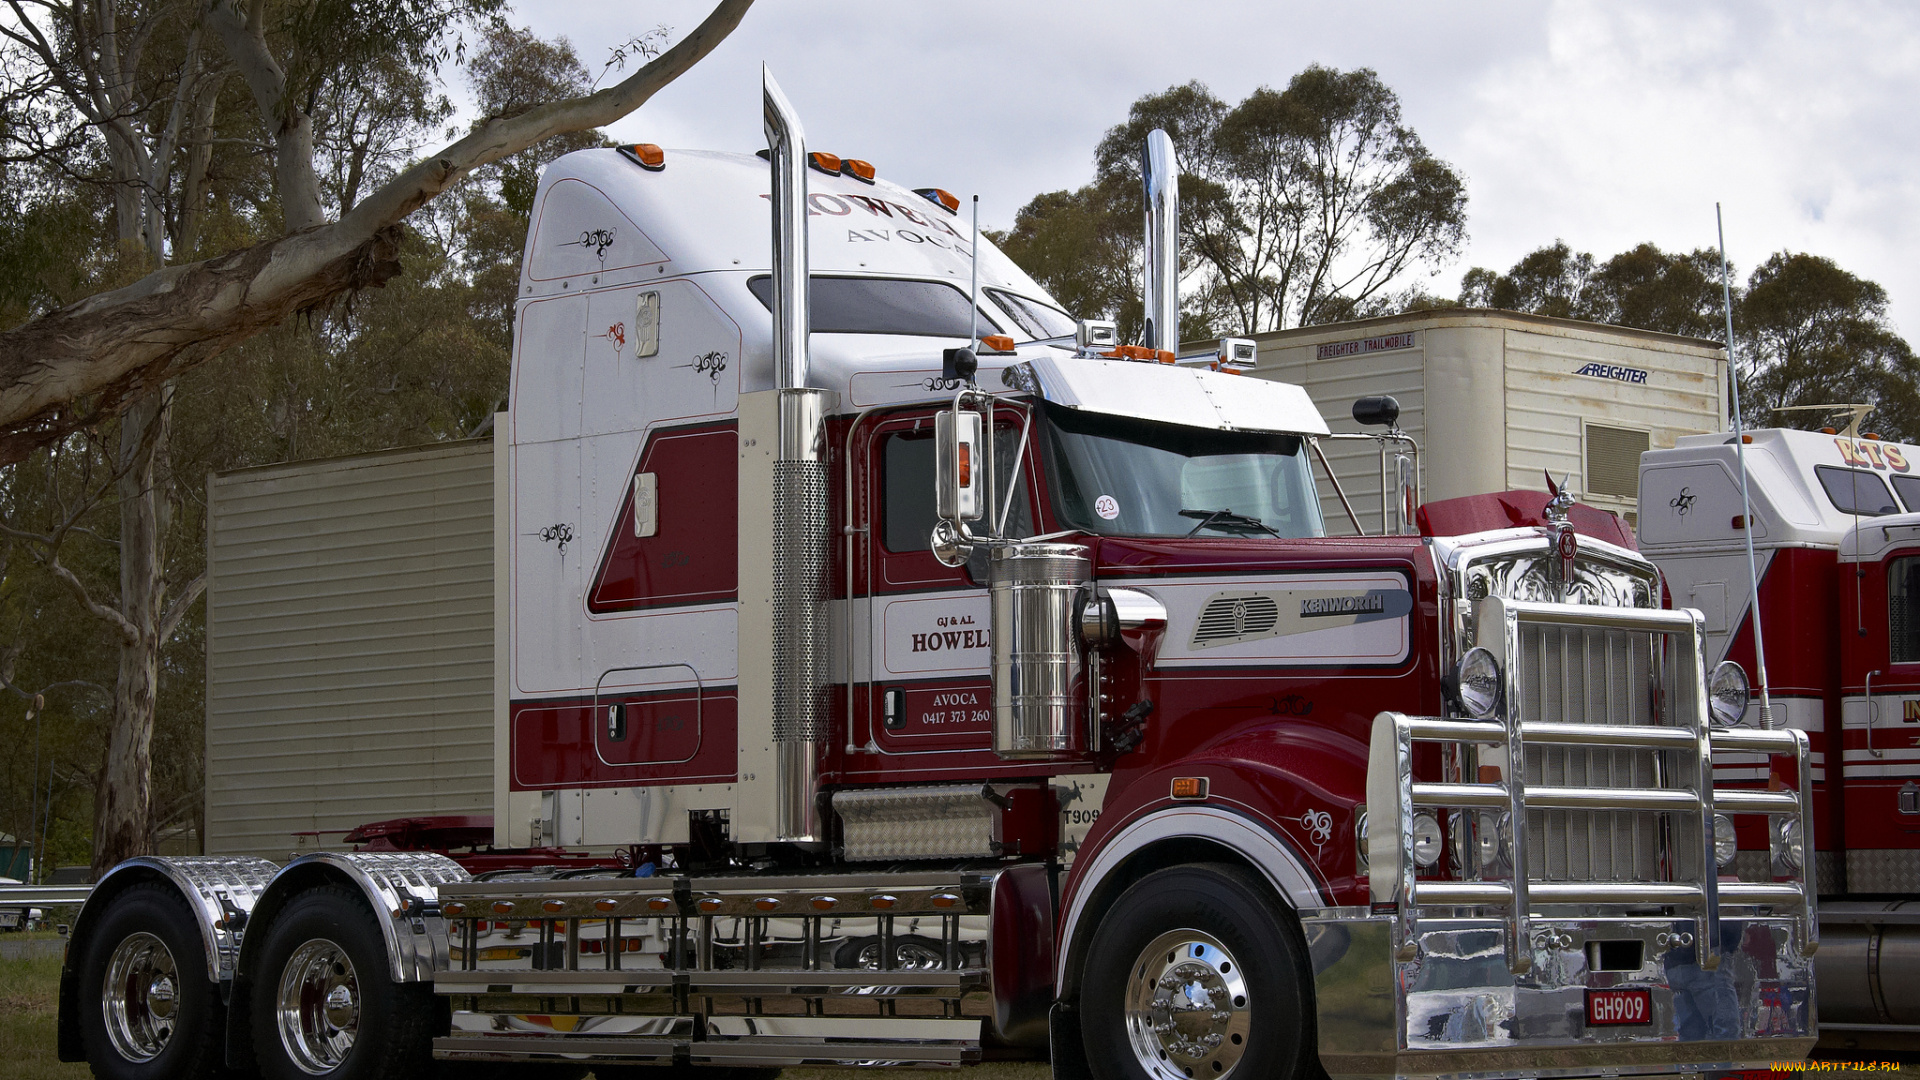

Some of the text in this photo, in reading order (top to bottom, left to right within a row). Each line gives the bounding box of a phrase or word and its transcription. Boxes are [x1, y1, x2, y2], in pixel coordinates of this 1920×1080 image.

[847, 228, 973, 258] AVOCA
[1319, 335, 1411, 357] FREIGHTER TRAILMOBILE
[1573, 362, 1648, 385] FREIGHTER
[1834, 438, 1911, 473] RTS
[1300, 594, 1384, 616] KENWORTH
[950, 616, 958, 625] &
[933, 693, 978, 706] AVOCA
[922, 709, 990, 724] 0417 373 260
[1063, 809, 1100, 824] T909
[1594, 996, 1643, 1020] GH909
